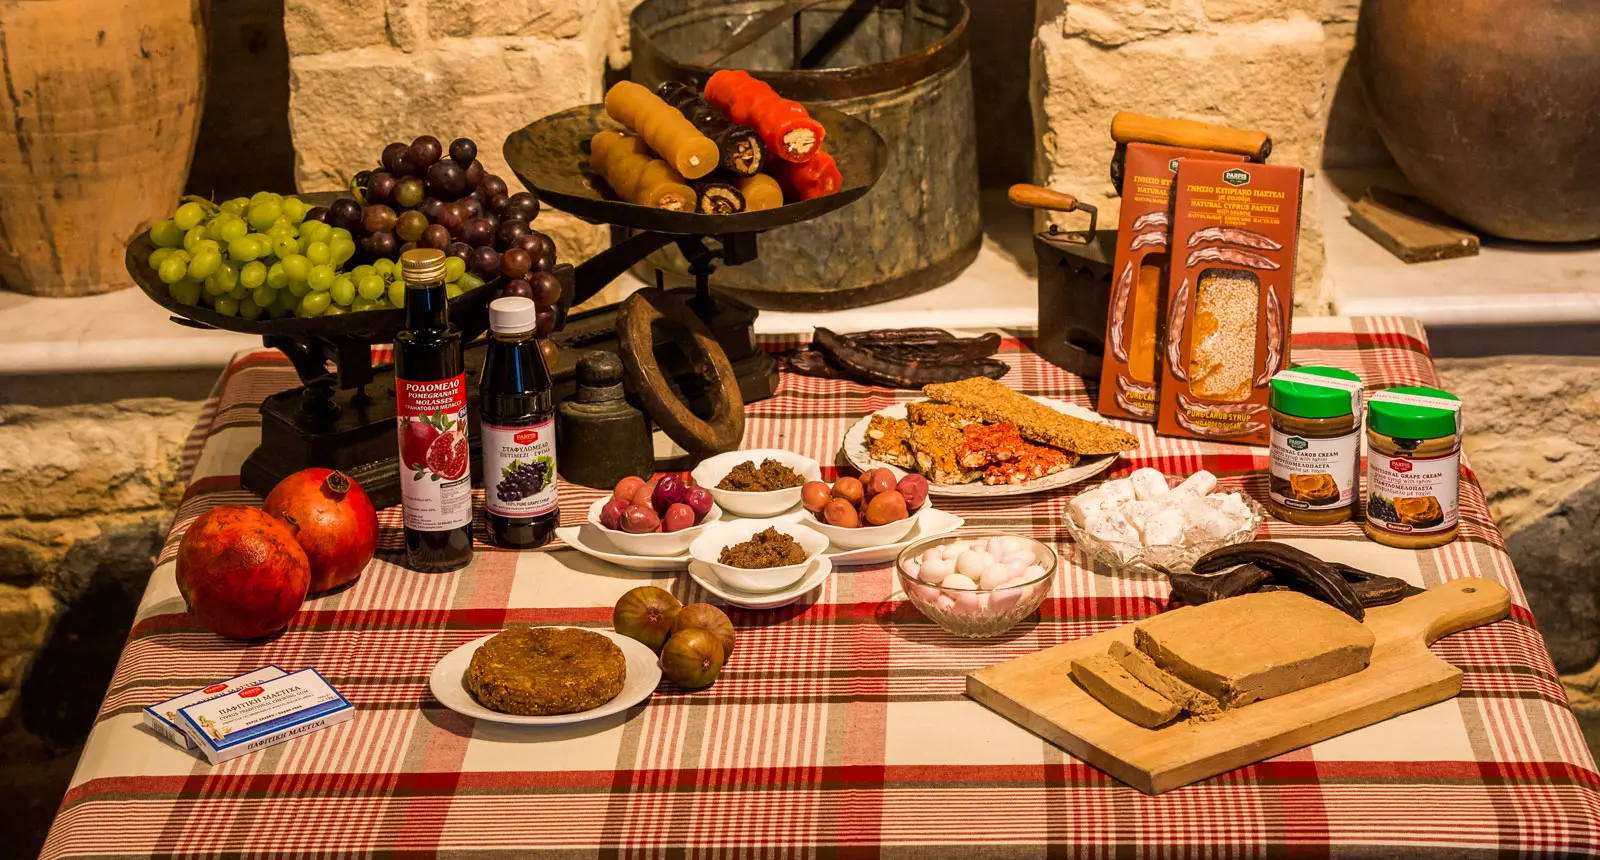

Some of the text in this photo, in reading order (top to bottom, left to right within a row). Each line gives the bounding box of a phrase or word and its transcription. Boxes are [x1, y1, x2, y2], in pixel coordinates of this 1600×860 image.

[1187, 185, 1285, 198] ΓΝΗΣΙΟ ΚΥΠΡΙΑΚΟ ΠΑΣΤΕΛΙ
[1191, 200, 1279, 213] NATURAL CYPRUS PASTELI
[406, 379, 460, 392] ΡΟΔΟΜΕΛΟ
[408, 388, 459, 399] POMEGRANATE
[1125, 391, 1143, 400] PURE
[415, 397, 453, 406] MOLASSES
[1187, 409, 1251, 422] PURE CAROB SYRUP
[502, 441, 549, 453] ΣΤΑΦΥΛΟΜΕΛΟ
[1387, 476, 1401, 484] syrup
[218, 698, 261, 715] ΠΑΦΙΤΙΚΗ
[263, 685, 301, 700] ΜΑΣΤΙΧΑ
[247, 733, 287, 750] ΠΑΦΙΤΙΚΗ
[288, 719, 326, 736] ΜΑΣΤΙΧΑ
